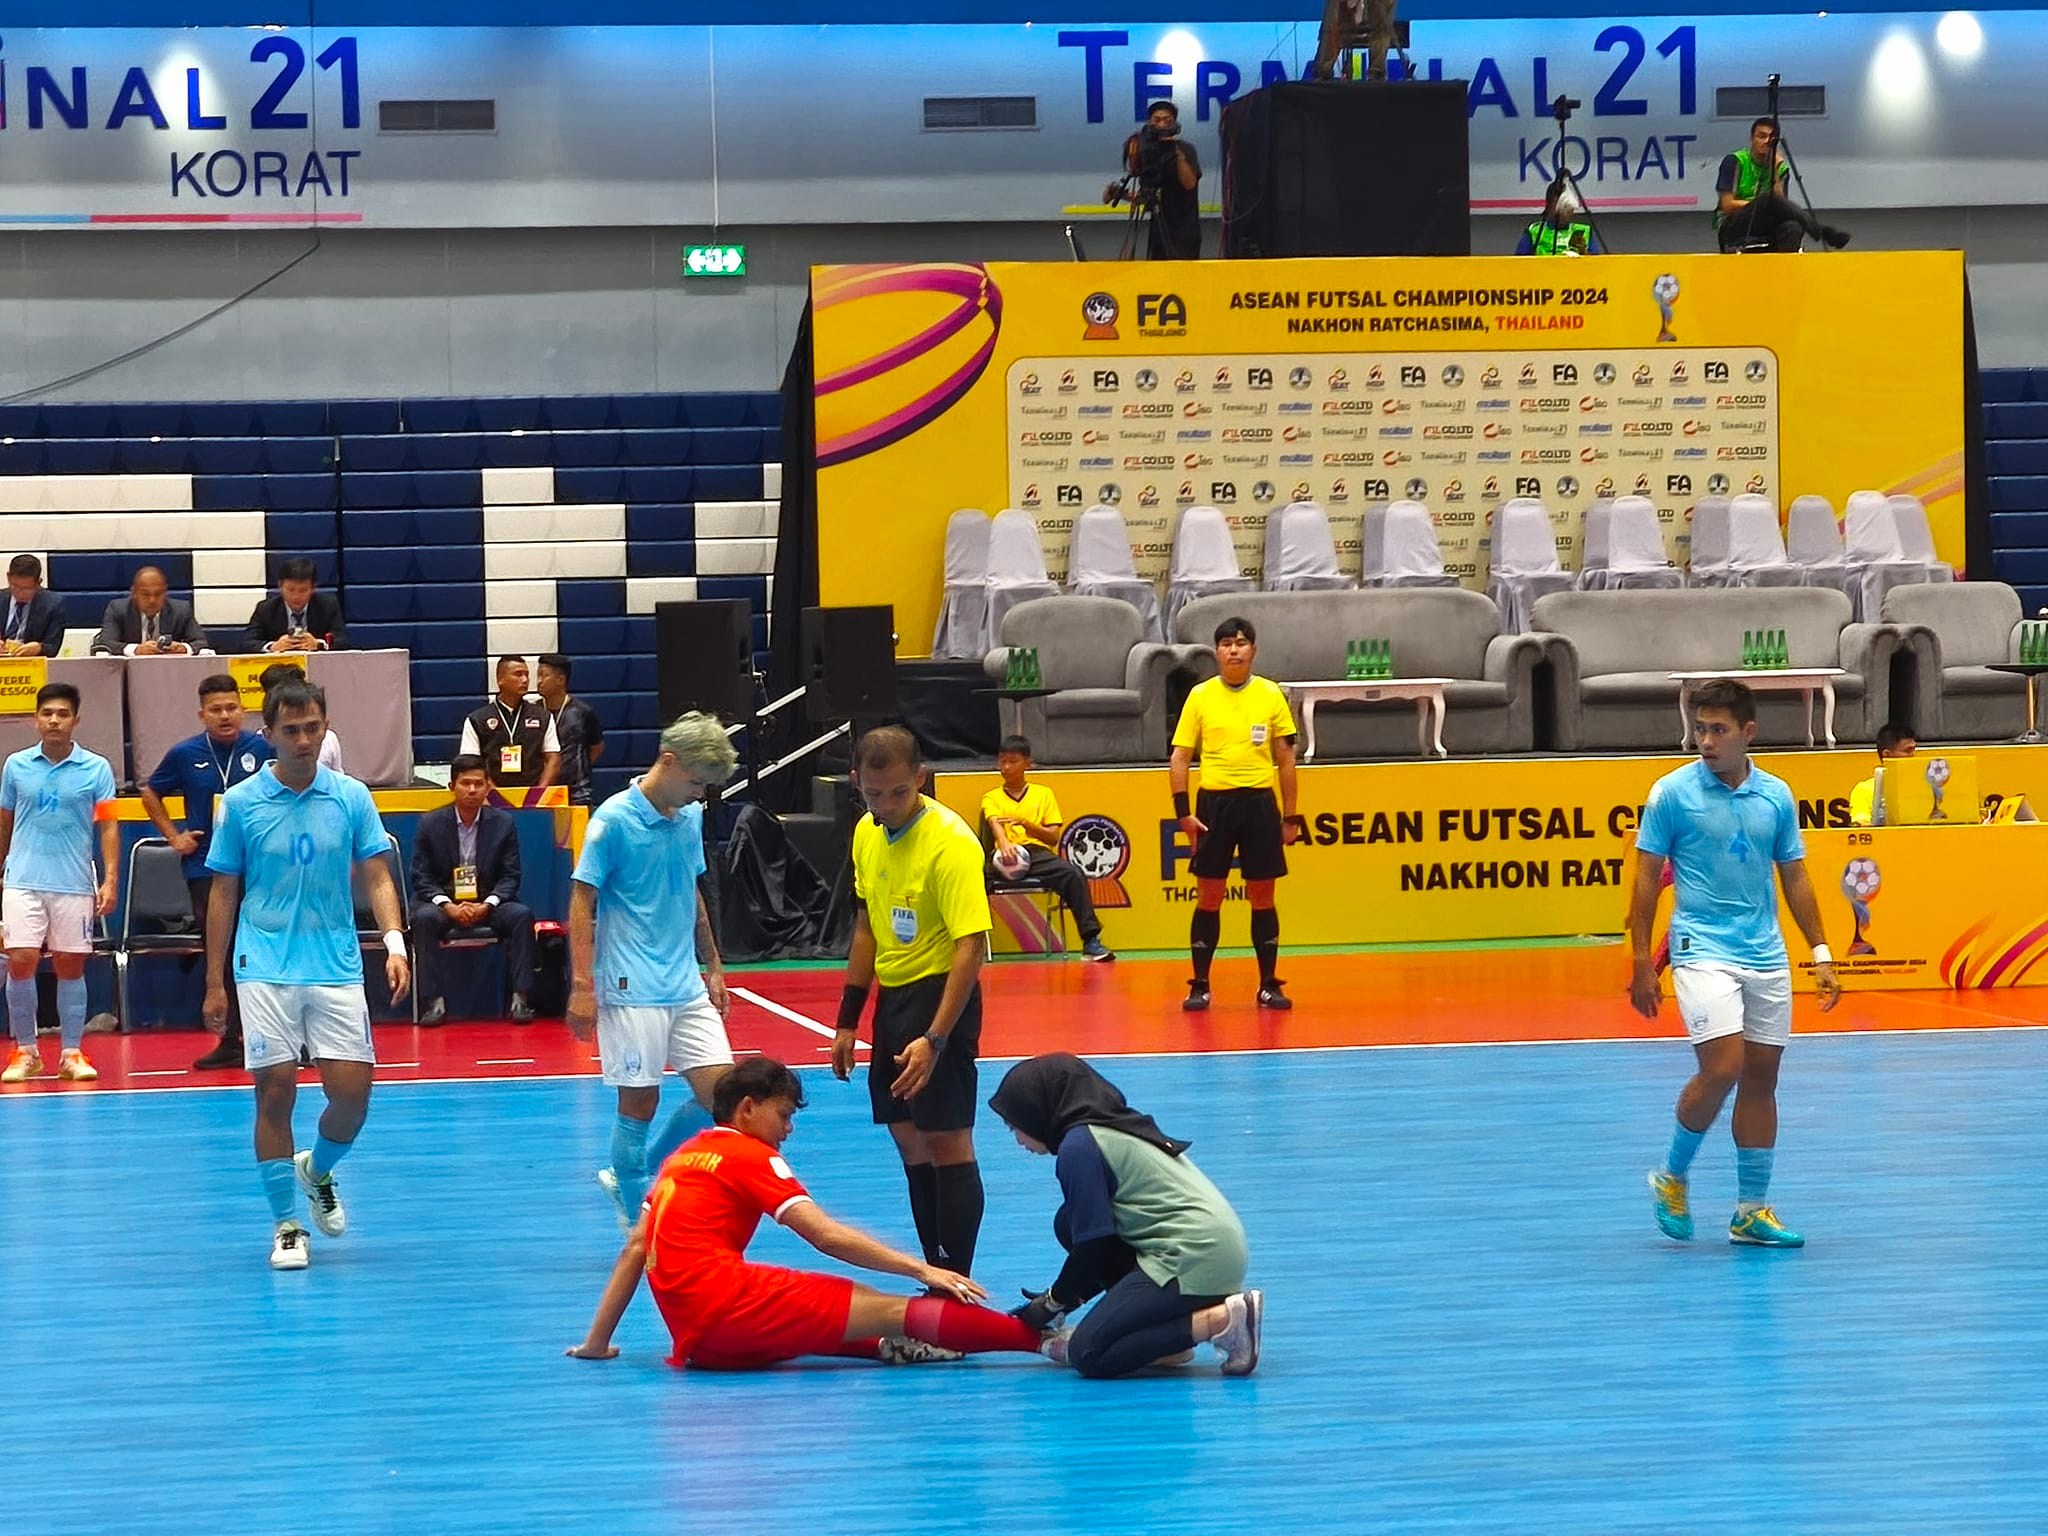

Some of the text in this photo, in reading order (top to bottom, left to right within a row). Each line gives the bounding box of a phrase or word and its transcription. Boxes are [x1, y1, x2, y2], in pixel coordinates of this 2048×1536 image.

[1592, 25, 1697, 117] 21
[250, 36, 361, 130] 21
[1519, 134, 1698, 183] KORAT
[171, 149, 361, 197] KORAT
[1229, 286, 1609, 310] ASEAN FUTSAL CHAMPIONSHIP 2024
[1137, 294, 1187, 327] FA
[1287, 314, 1585, 334] NAKHON RATCHASIMA, THAILAND
[1094, 370, 1119, 387] FA
[1248, 368, 1273, 385] FA
[1401, 365, 1426, 382] FA
[1553, 364, 1578, 380] FA
[1705, 362, 1730, 378] FA
[1212, 482, 1237, 498] FA
[1365, 479, 1390, 496] FA
[1516, 477, 1541, 494] FA
[1667, 474, 1692, 491] FA
[1058, 485, 1083, 502] FA
[1298, 810, 1423, 847] ASEAN
[1439, 807, 1594, 843] FUTSAL
[289, 833, 315, 866] 10
[1401, 862, 1550, 891] NAKHON
[893, 908, 915, 920] FIFA
